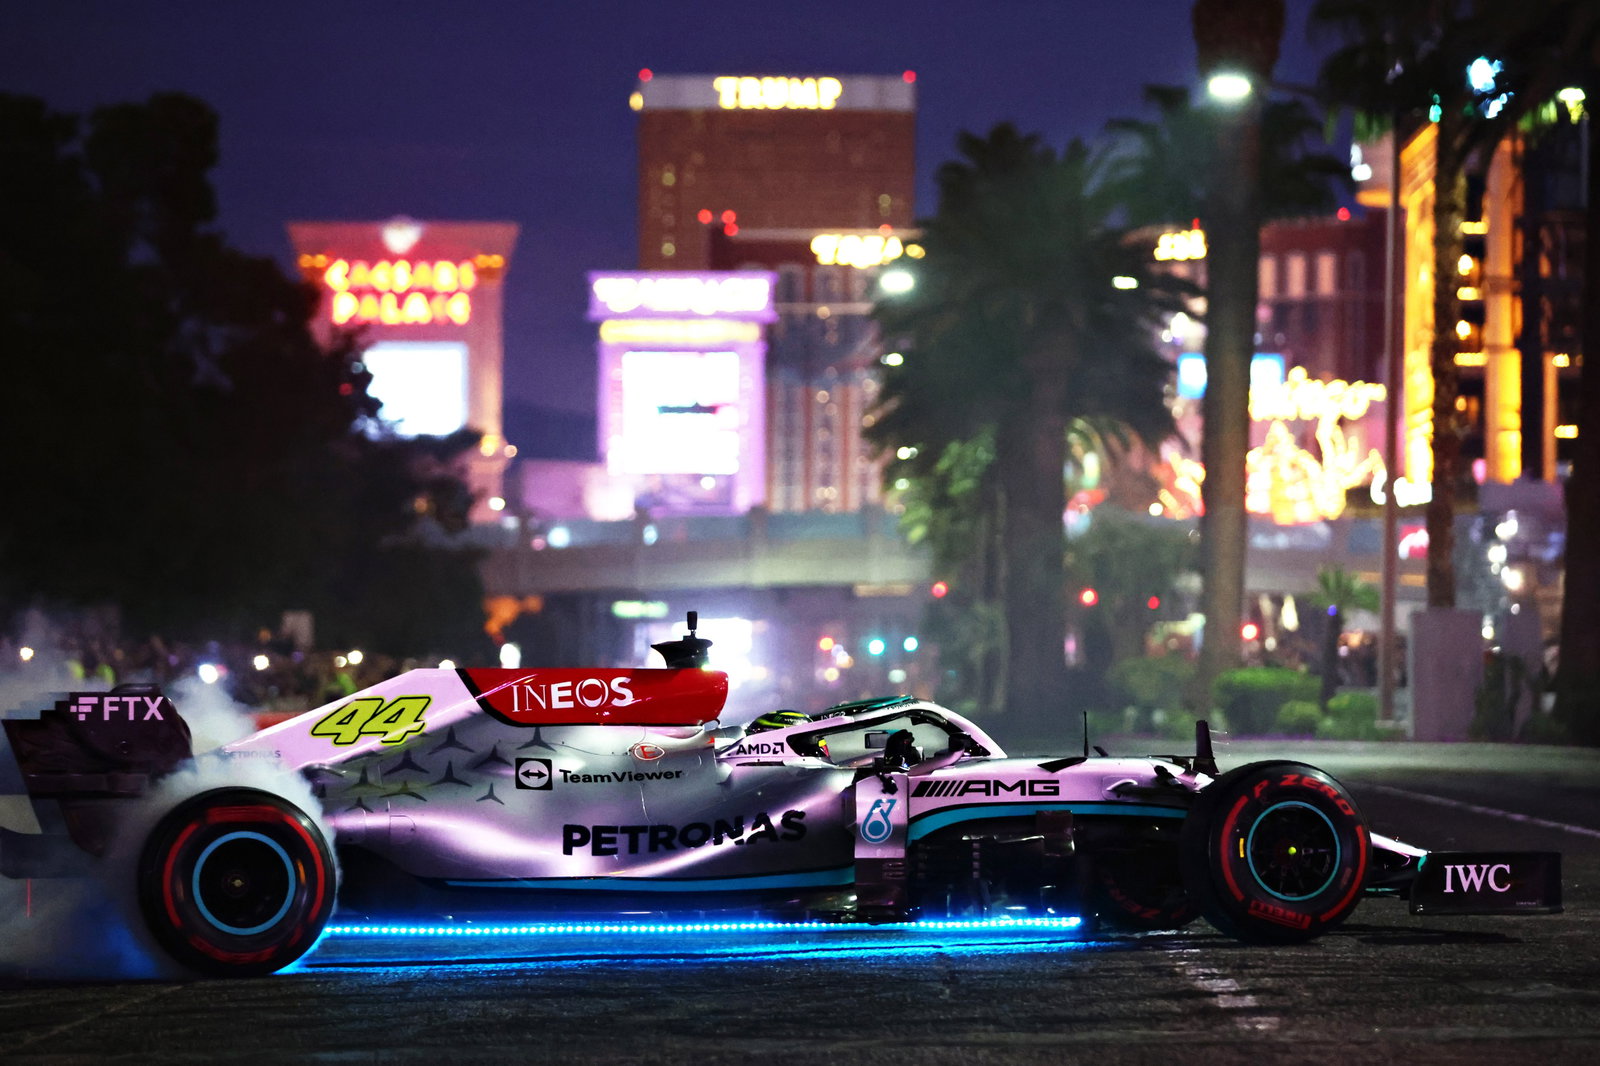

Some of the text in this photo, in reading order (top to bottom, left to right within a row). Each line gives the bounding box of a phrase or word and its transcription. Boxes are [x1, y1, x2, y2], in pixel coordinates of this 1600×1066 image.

[713, 77, 842, 109] TRUMP
[104, 697, 164, 721] FTX
[511, 677, 634, 712] INEOS
[311, 696, 432, 745] 44
[736, 744, 771, 755] AMD
[559, 769, 682, 783] TeamViewer
[957, 780, 1059, 796] AMG
[1280, 774, 1356, 815] ZERO
[563, 810, 806, 856] PETRONAS
[1443, 864, 1511, 893] IWC
